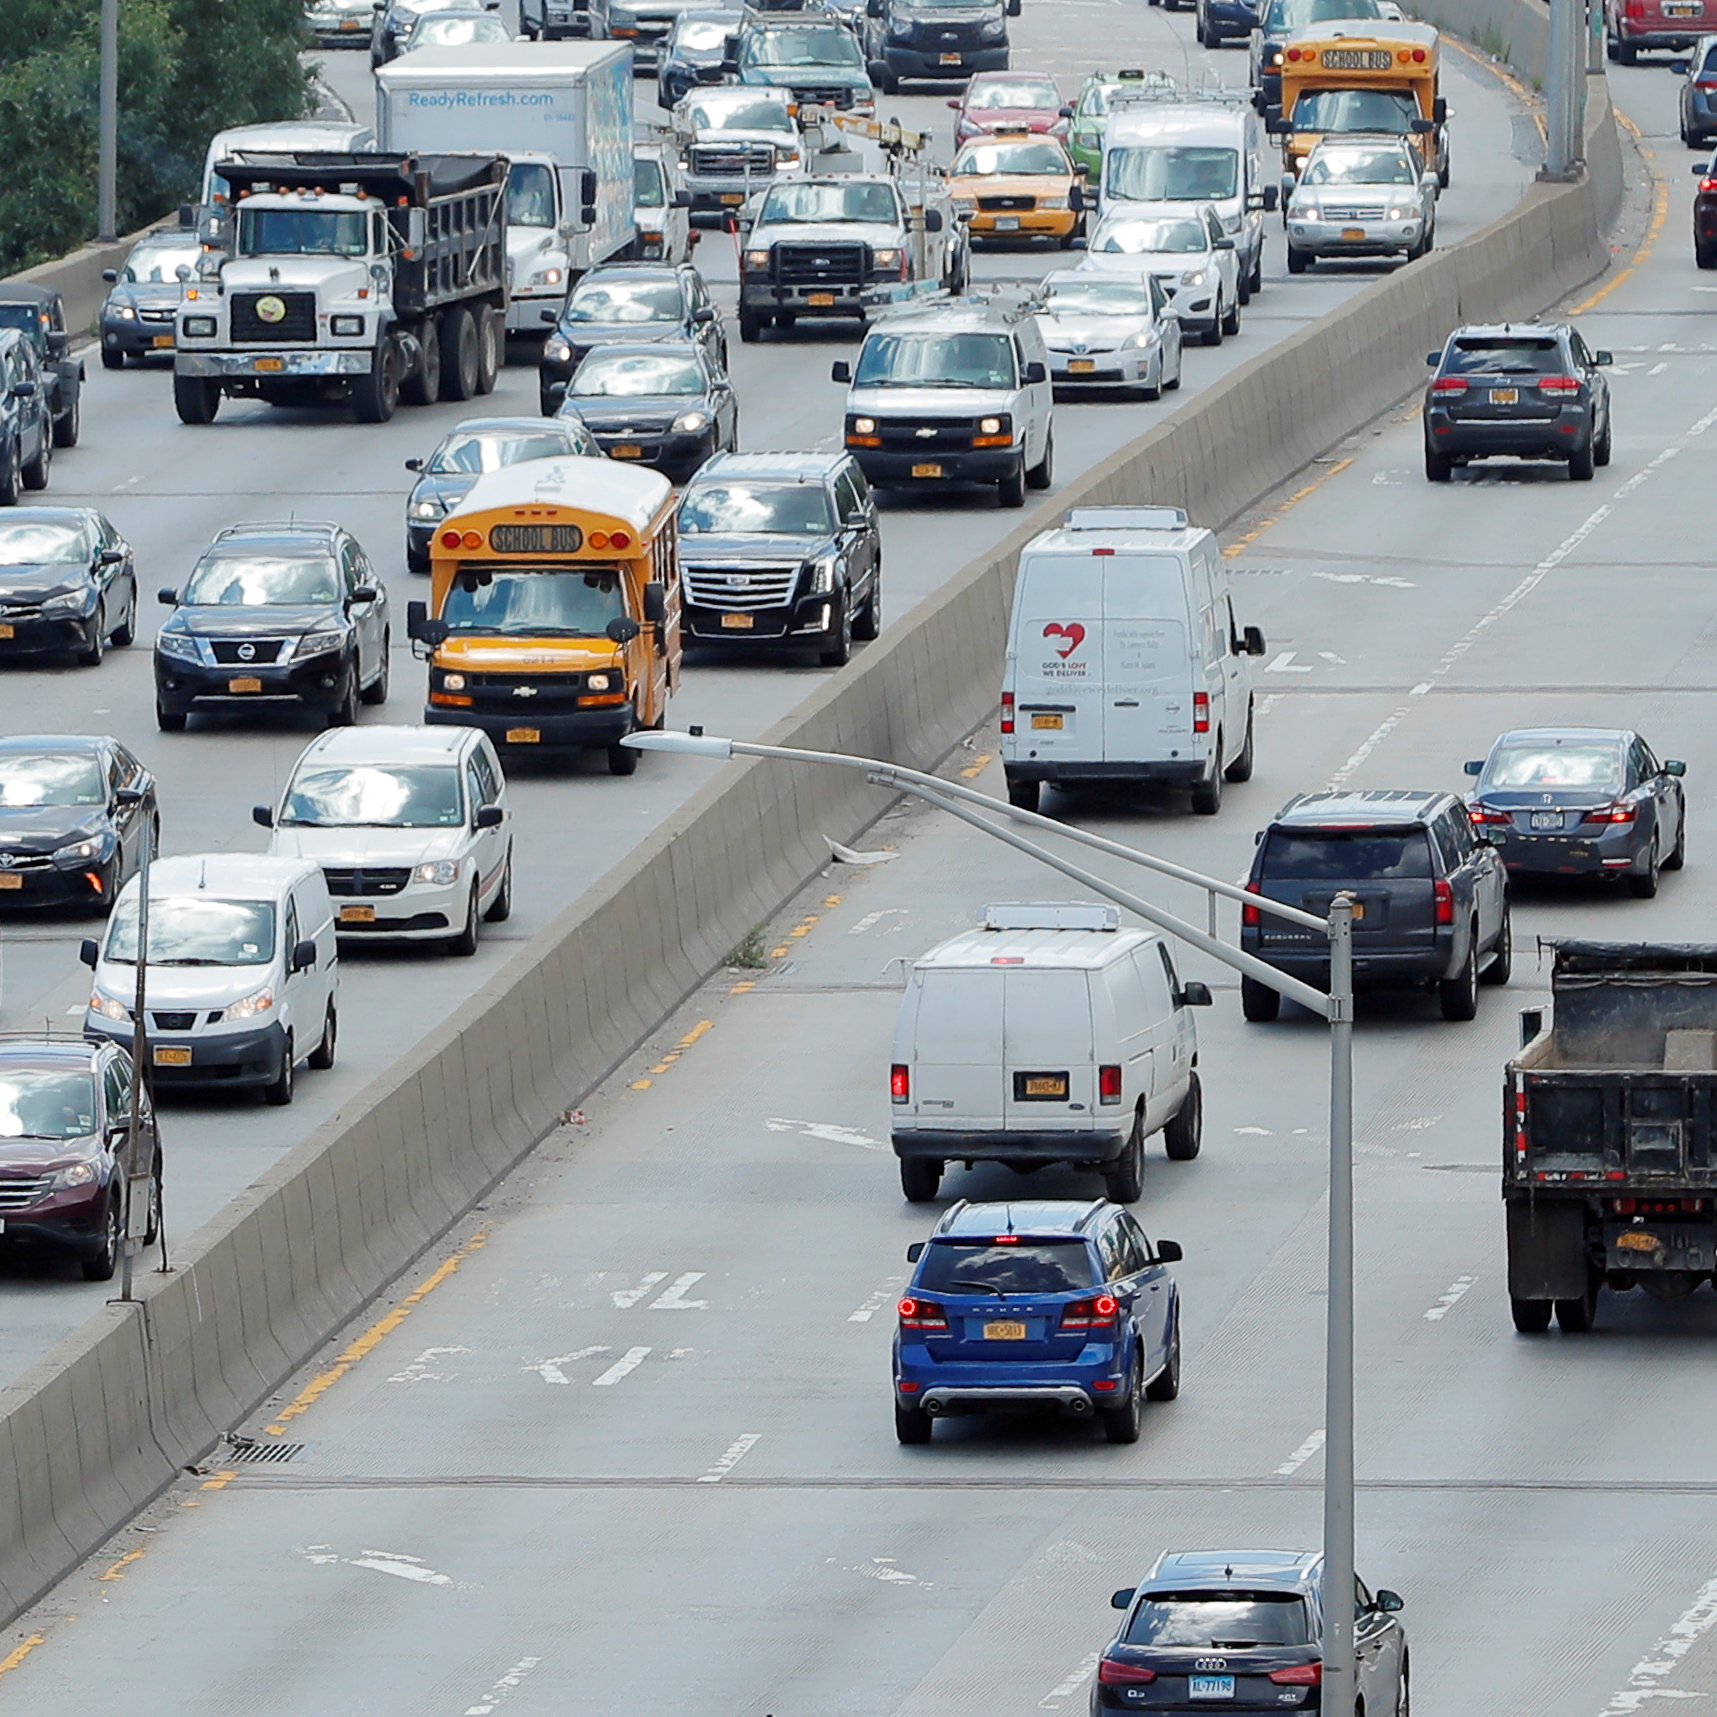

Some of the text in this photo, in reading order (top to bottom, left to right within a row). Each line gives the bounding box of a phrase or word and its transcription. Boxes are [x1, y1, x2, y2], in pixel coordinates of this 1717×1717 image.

[1322, 50, 1390, 68] SCHOOL BUS
[409, 91, 554, 110] ReadyRefresh.com
[495, 527, 577, 550] SCHOOL BUS
[1068, 662, 1087, 670] LOVE
